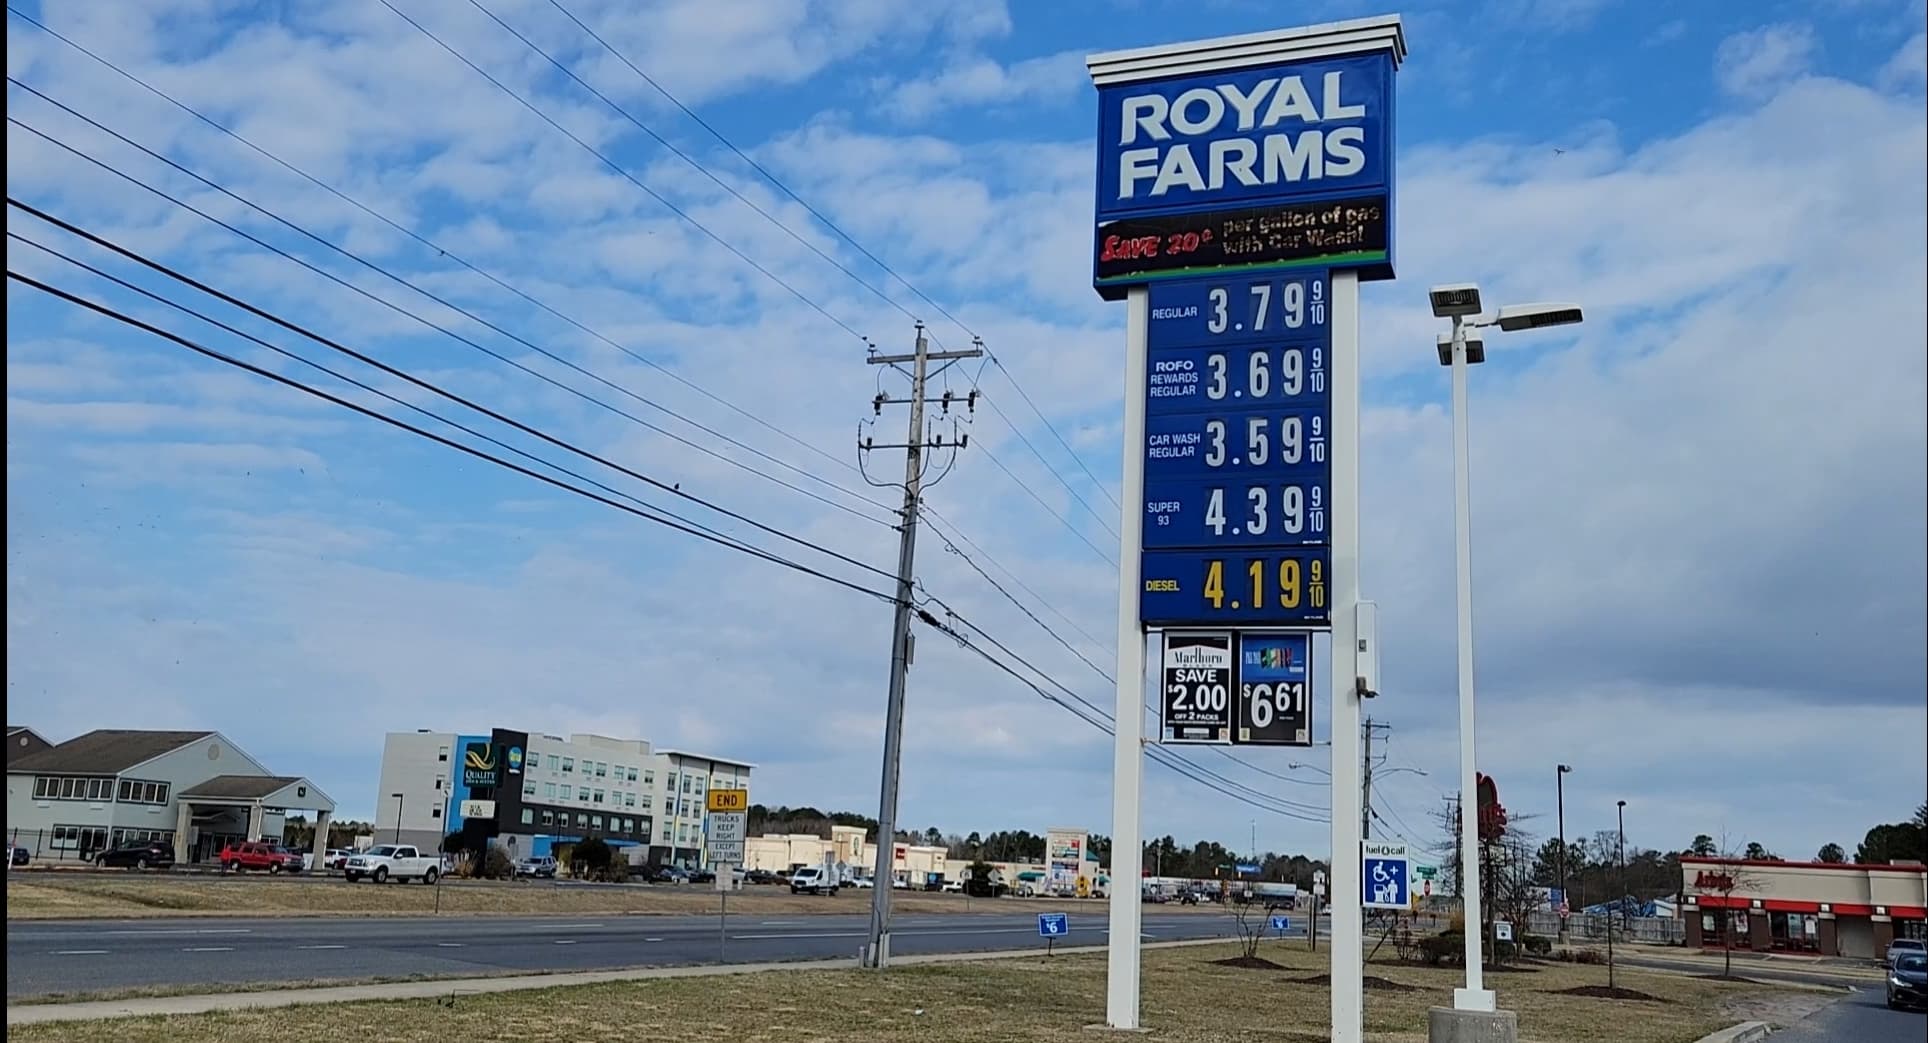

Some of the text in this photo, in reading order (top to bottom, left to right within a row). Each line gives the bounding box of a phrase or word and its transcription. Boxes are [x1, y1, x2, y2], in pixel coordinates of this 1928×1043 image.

[1119, 71, 1365, 146] ROYAL
[1118, 127, 1365, 200] FARMS
[1223, 206, 1380, 237] per gallon of gas
[1222, 235, 1264, 254] with
[1152, 282, 1304, 334] REGULAR 3.79
[1156, 360, 1194, 372] ROFO
[1150, 349, 1303, 400] REWARDS 3.69
[1150, 385, 1196, 398] REGULAR
[1149, 416, 1302, 467] CAR WASH 3.59
[1149, 446, 1195, 458] REGULAR
[1147, 486, 1304, 536] SUPER 4.39
[1157, 515, 1170, 526] 93
[1146, 559, 1300, 609] DIESEL 4.19
[1175, 669, 1217, 682] SAVE
[1168, 684, 1226, 711] $2.00
[1188, 711, 1195, 720] 2
[465, 769, 496, 778] QUALITY
[717, 794, 738, 807] END
[714, 815, 740, 823] TRUCKS
[709, 851, 741, 859] LEFT TURNS
[1366, 845, 1405, 855] fuel call
